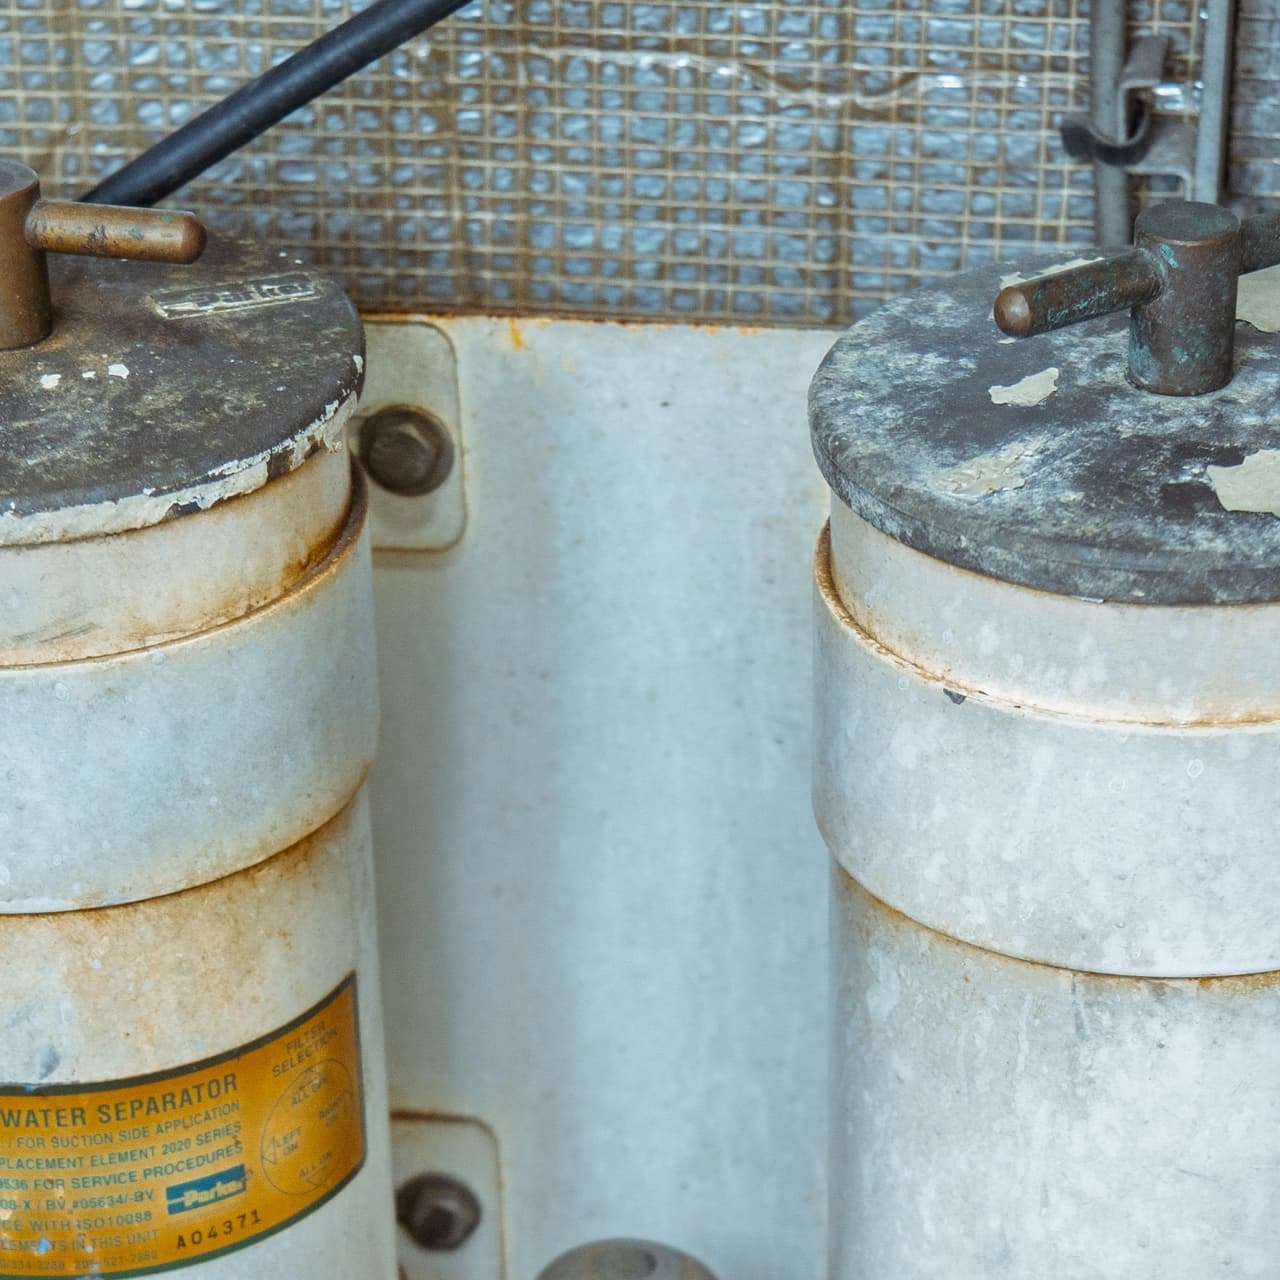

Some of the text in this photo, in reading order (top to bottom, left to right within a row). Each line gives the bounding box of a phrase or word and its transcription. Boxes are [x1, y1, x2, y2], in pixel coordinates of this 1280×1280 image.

[97, 1072, 238, 1125] SEPARATOR
[16, 1136, 46, 1149] FOR
[50, 1131, 114, 1149] SUCTION
[118, 1125, 151, 1144] SIDE
[154, 1098, 241, 1136] APPLICATION
[89, 1146, 157, 1168] ELEMENT
[160, 1137, 192, 1156] 2020
[195, 1119, 243, 1147] SERIES
[33, 1177, 66, 1190] FOR
[70, 1170, 139, 1190] SERVICE
[143, 1141, 245, 1180] PROCEDURES
[28, 1218, 72, 1233] WITH
[45, 1198, 67, 1211] BV
[90, 1235, 122, 1250] THIS
[126, 1228, 160, 1245] UNIT
